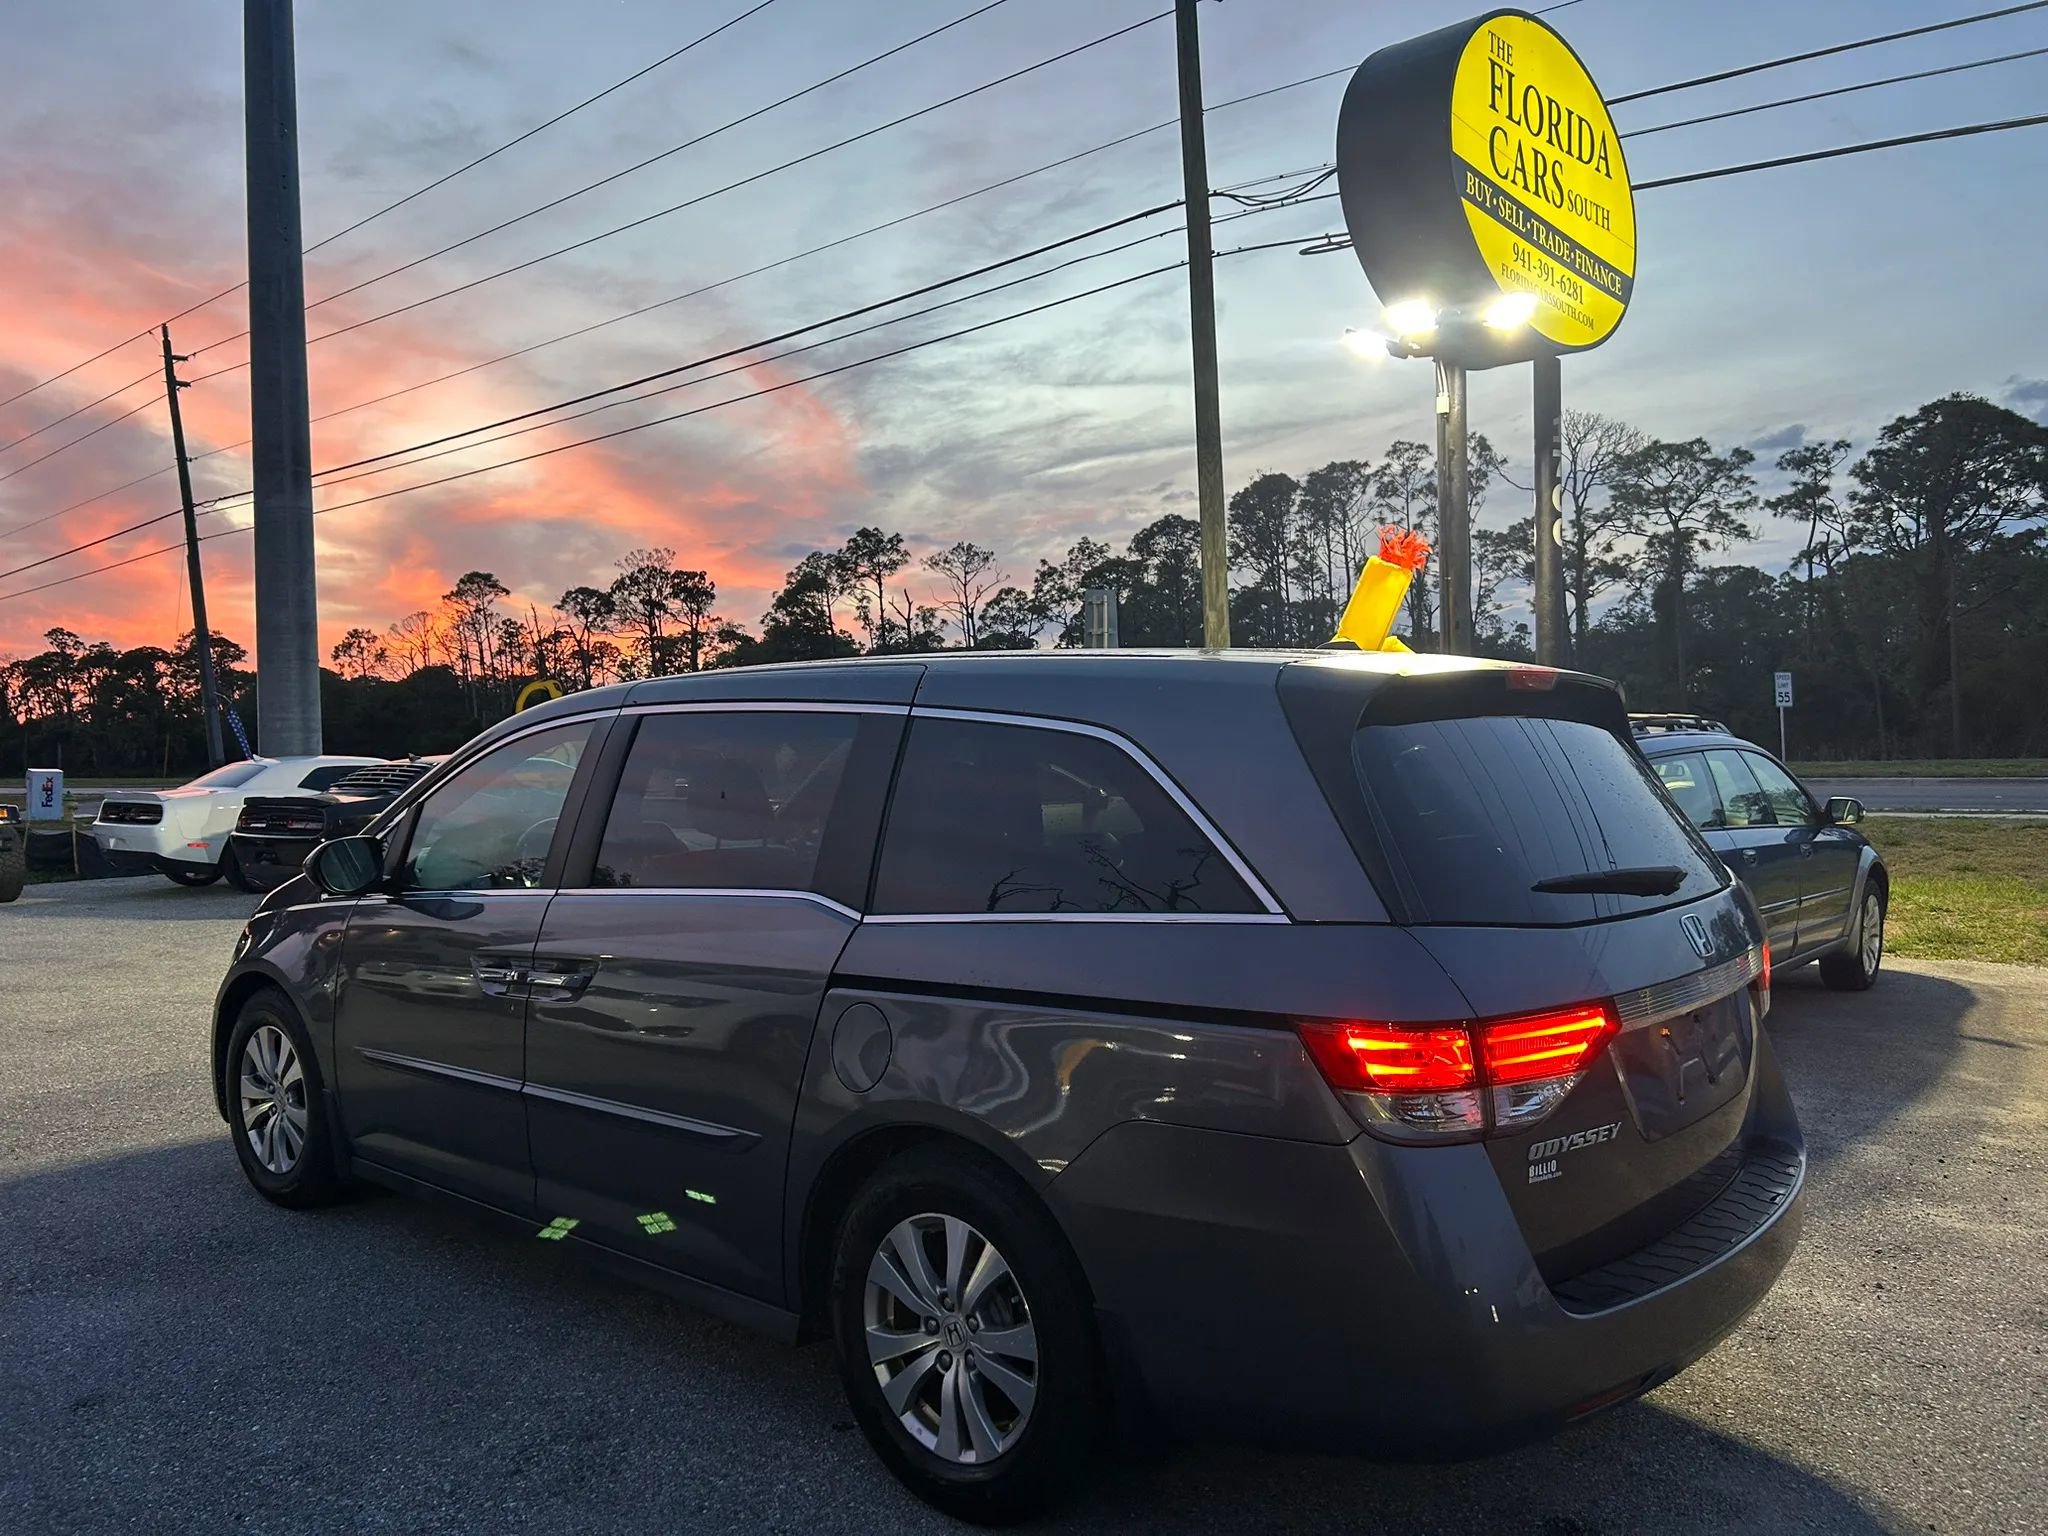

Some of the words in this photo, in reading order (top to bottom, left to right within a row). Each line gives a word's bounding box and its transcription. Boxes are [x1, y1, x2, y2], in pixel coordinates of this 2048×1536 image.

[1488, 30, 1513, 67] THE
[1488, 57, 1613, 179] FLORIDA
[1489, 125, 1564, 209] CARS
[1567, 189, 1611, 232] SOUTH
[1466, 171, 1492, 208] BUY
[1498, 195, 1526, 233] SELL
[1531, 218, 1571, 262] TRADE
[1575, 250, 1622, 296] FINANCE
[1512, 242, 1584, 305] 941-391-6281
[1778, 691, 1790, 703] 55
[41, 777, 54, 808] FedEx
[1527, 1121, 1622, 1161] ODYSSEY
